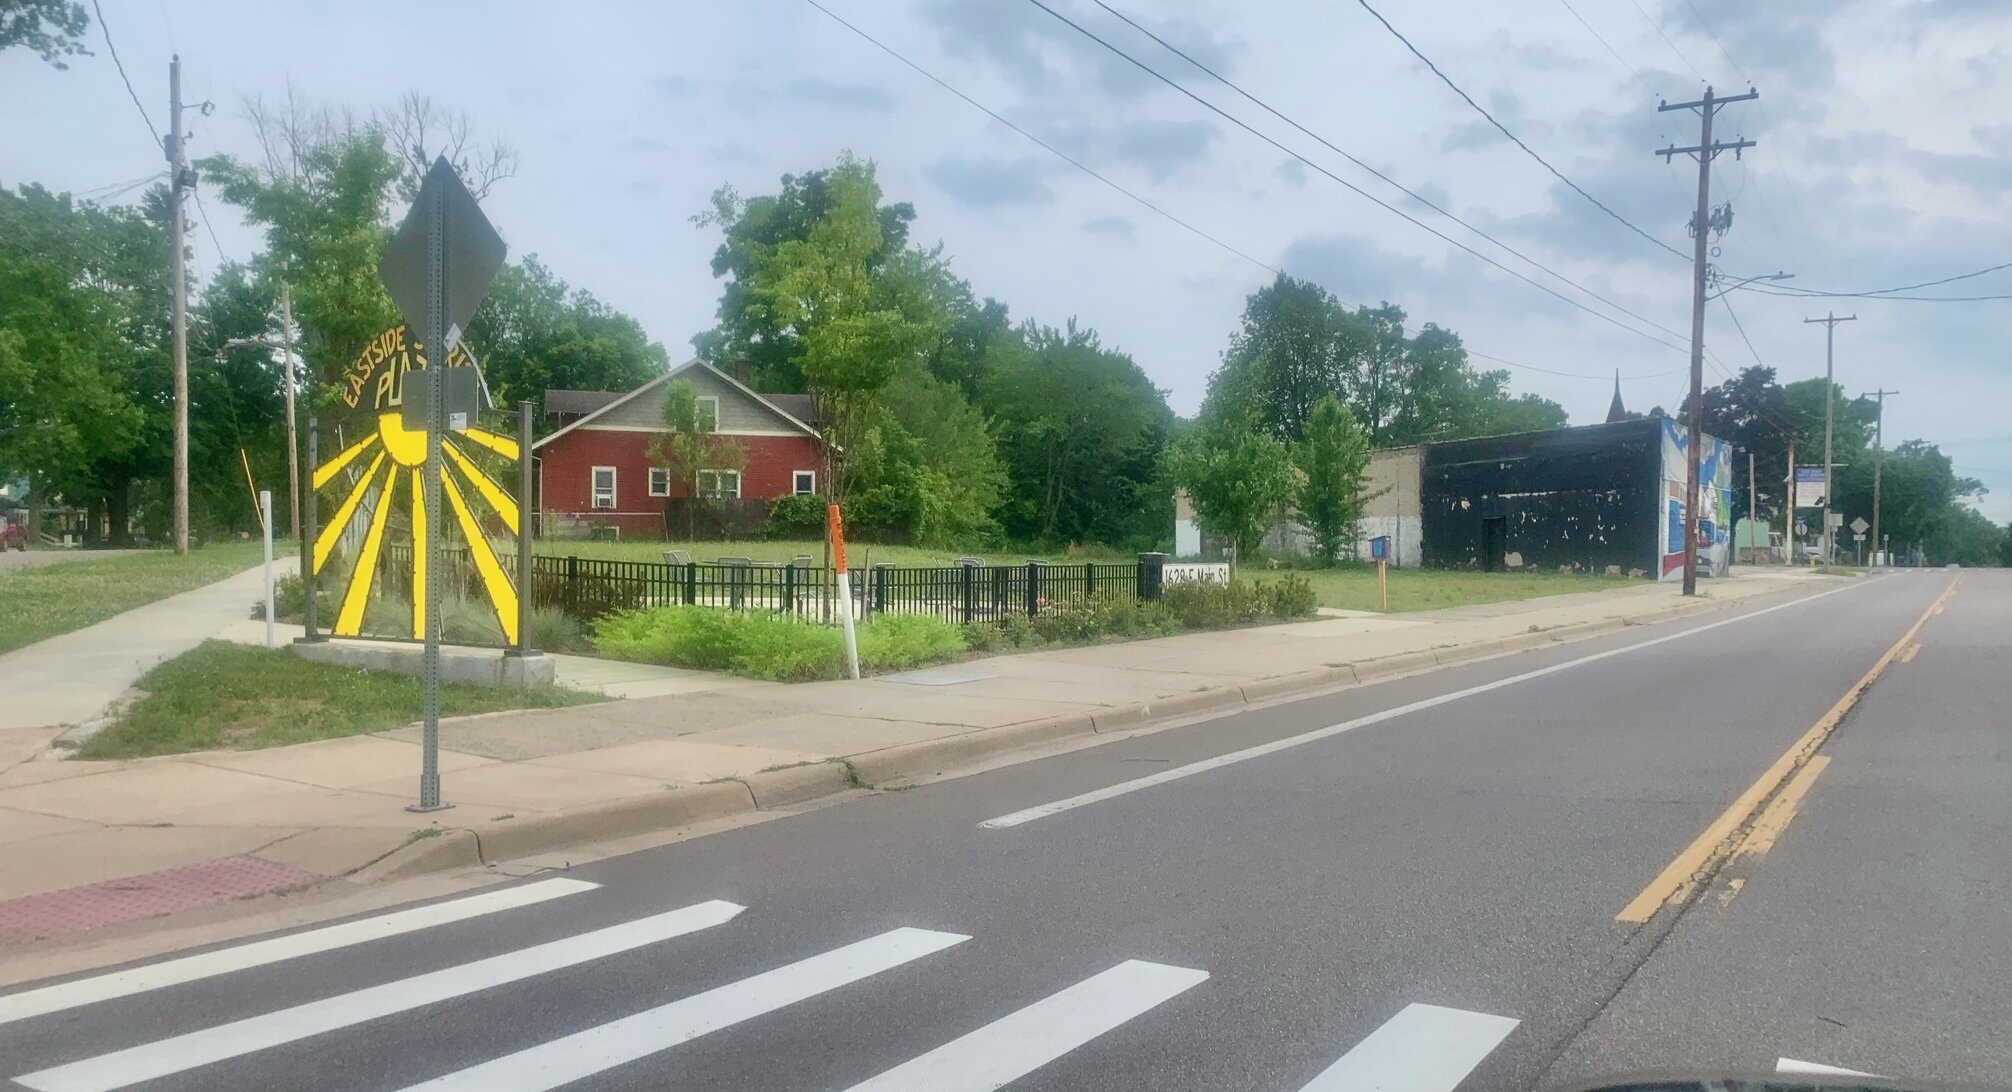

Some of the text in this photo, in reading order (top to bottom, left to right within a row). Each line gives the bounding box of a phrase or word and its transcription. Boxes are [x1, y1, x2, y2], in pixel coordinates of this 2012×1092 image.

[343, 324, 406, 409] EASTSIDE
[1165, 568, 1186, 587] 1628
[1197, 567, 1215, 585] Main
[1218, 567, 1228, 586] St
